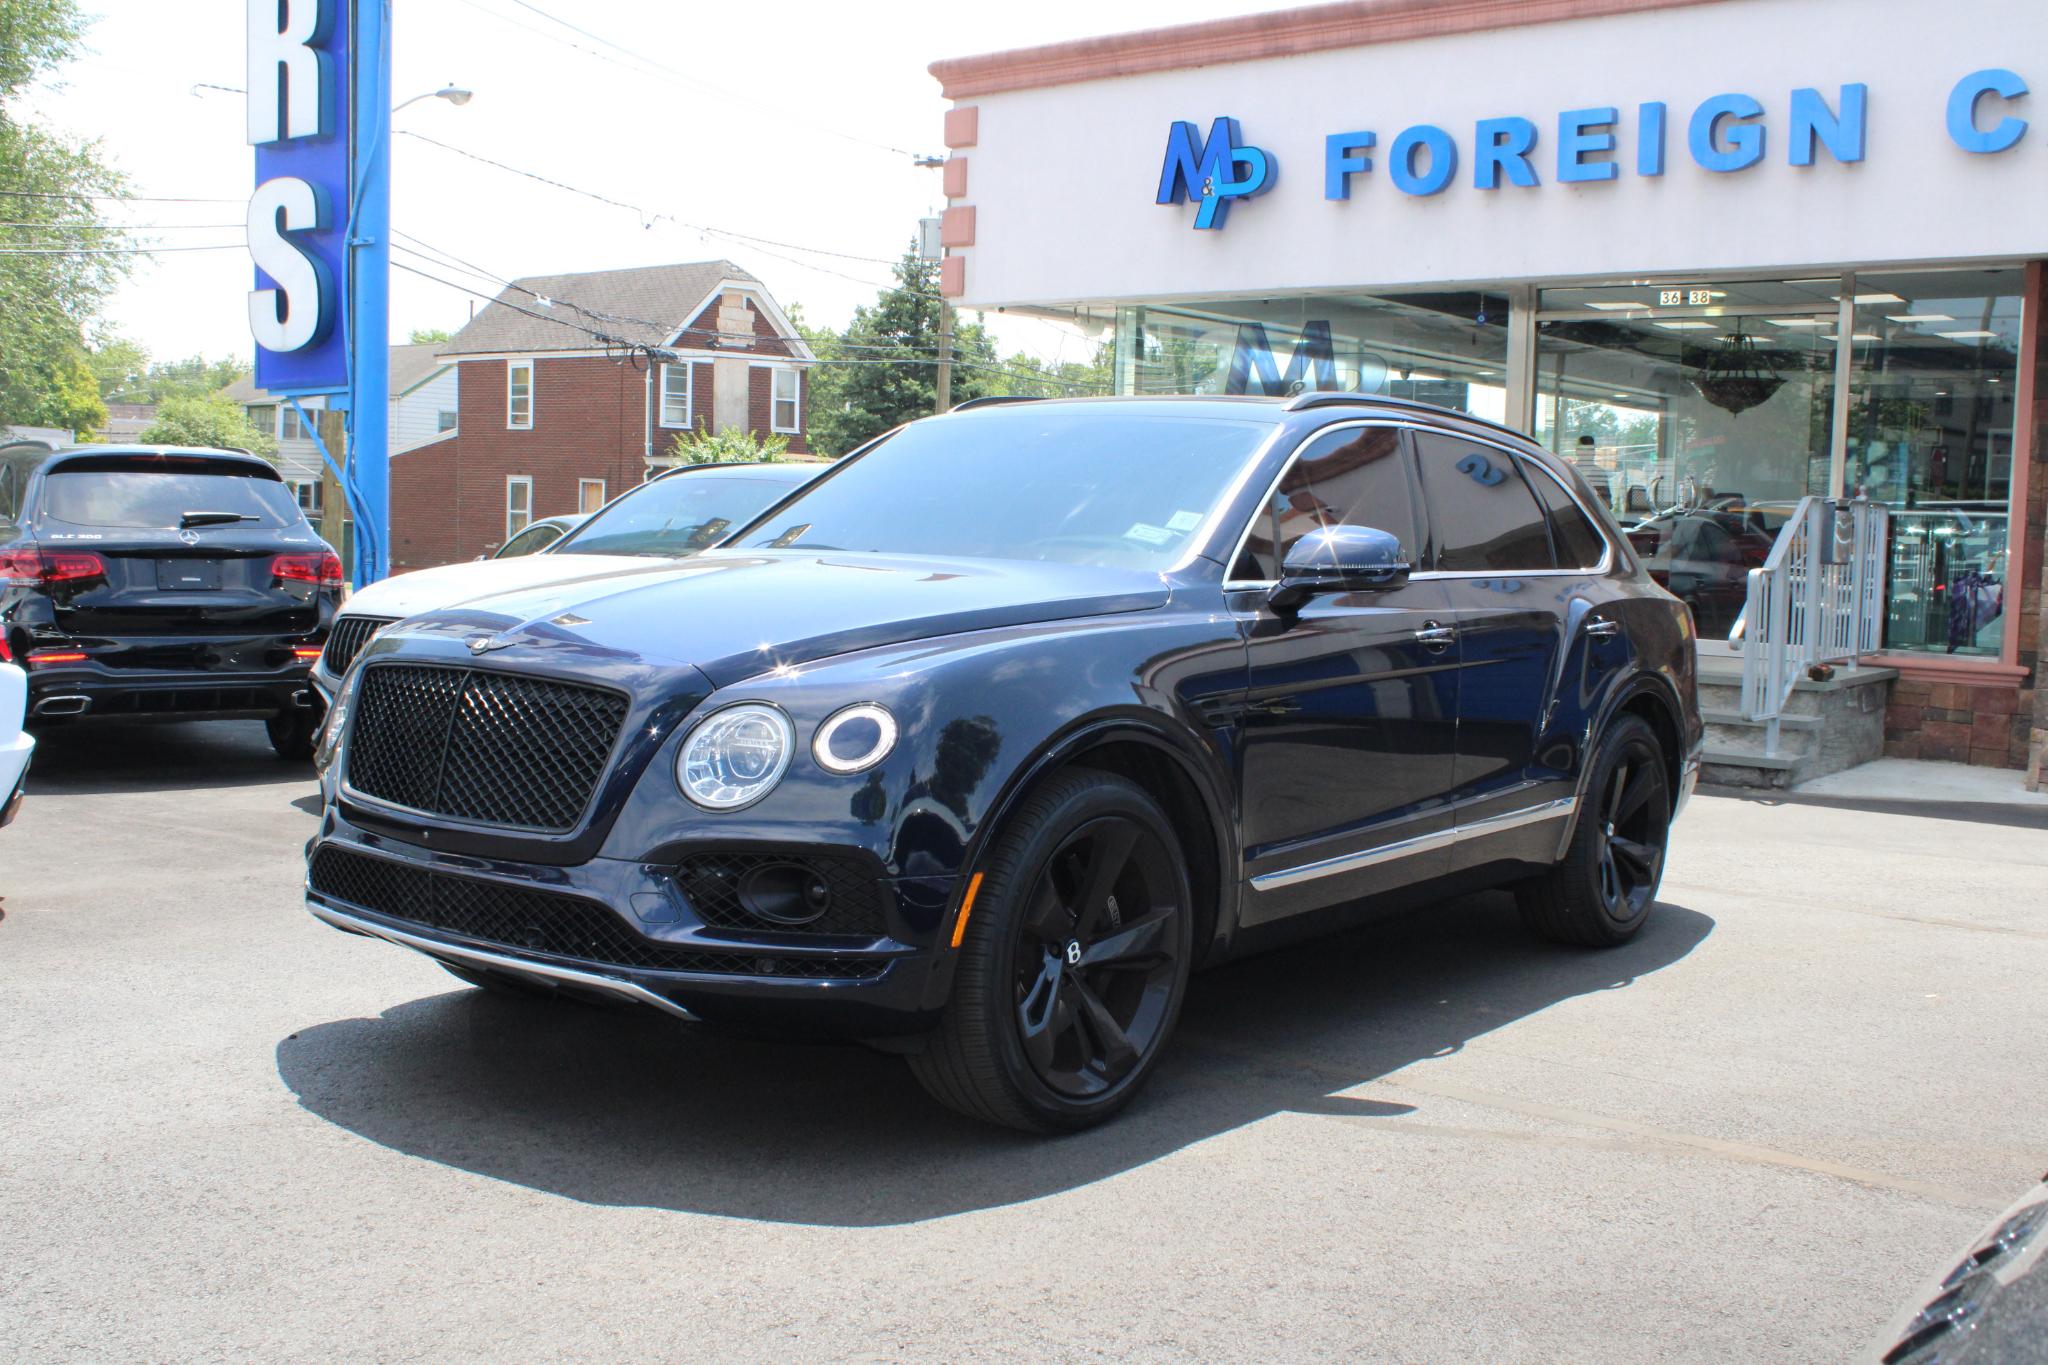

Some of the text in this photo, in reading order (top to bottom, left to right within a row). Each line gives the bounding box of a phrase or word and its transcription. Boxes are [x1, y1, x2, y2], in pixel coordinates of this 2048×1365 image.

[1325, 82, 1868, 201] FOREIGN
[1946, 68, 2030, 154] C
[1067, 941, 1081, 964] B
